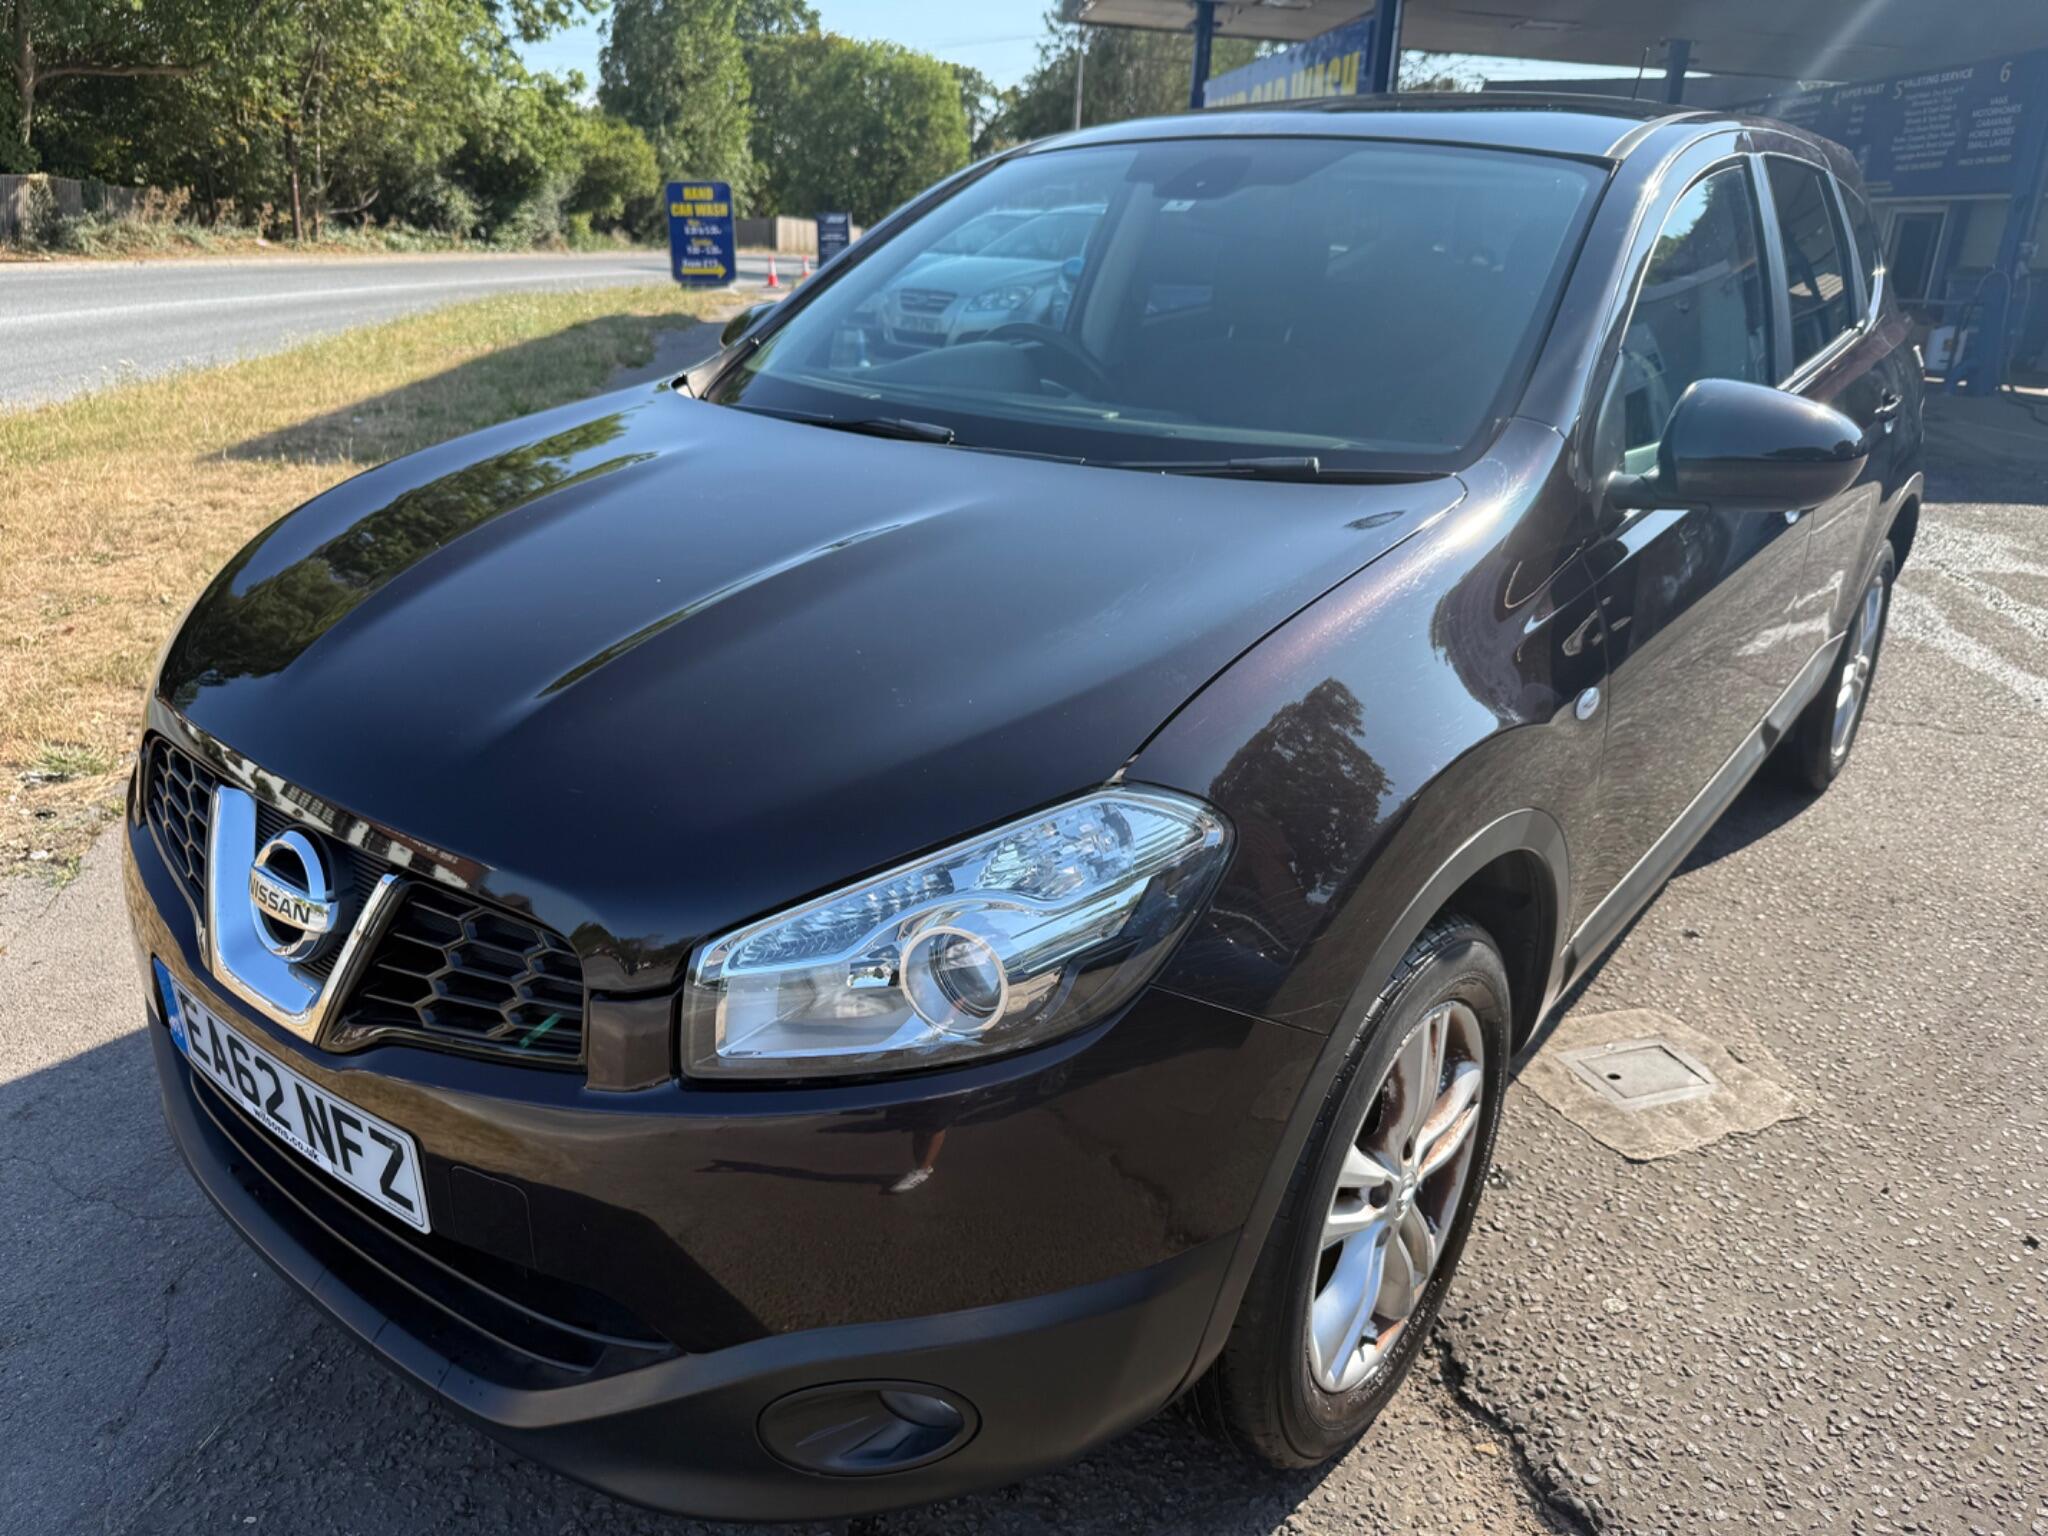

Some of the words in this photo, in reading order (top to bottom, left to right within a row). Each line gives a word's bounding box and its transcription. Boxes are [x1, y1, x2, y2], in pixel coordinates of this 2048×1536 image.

[1893, 80, 1904, 100] 5
[1940, 68, 1975, 83] SERVICE
[2000, 62, 2013, 83] 6
[250, 878, 311, 925] NISSAN
[177, 989, 291, 1131] EA62
[294, 1081, 415, 1213] NFZ
